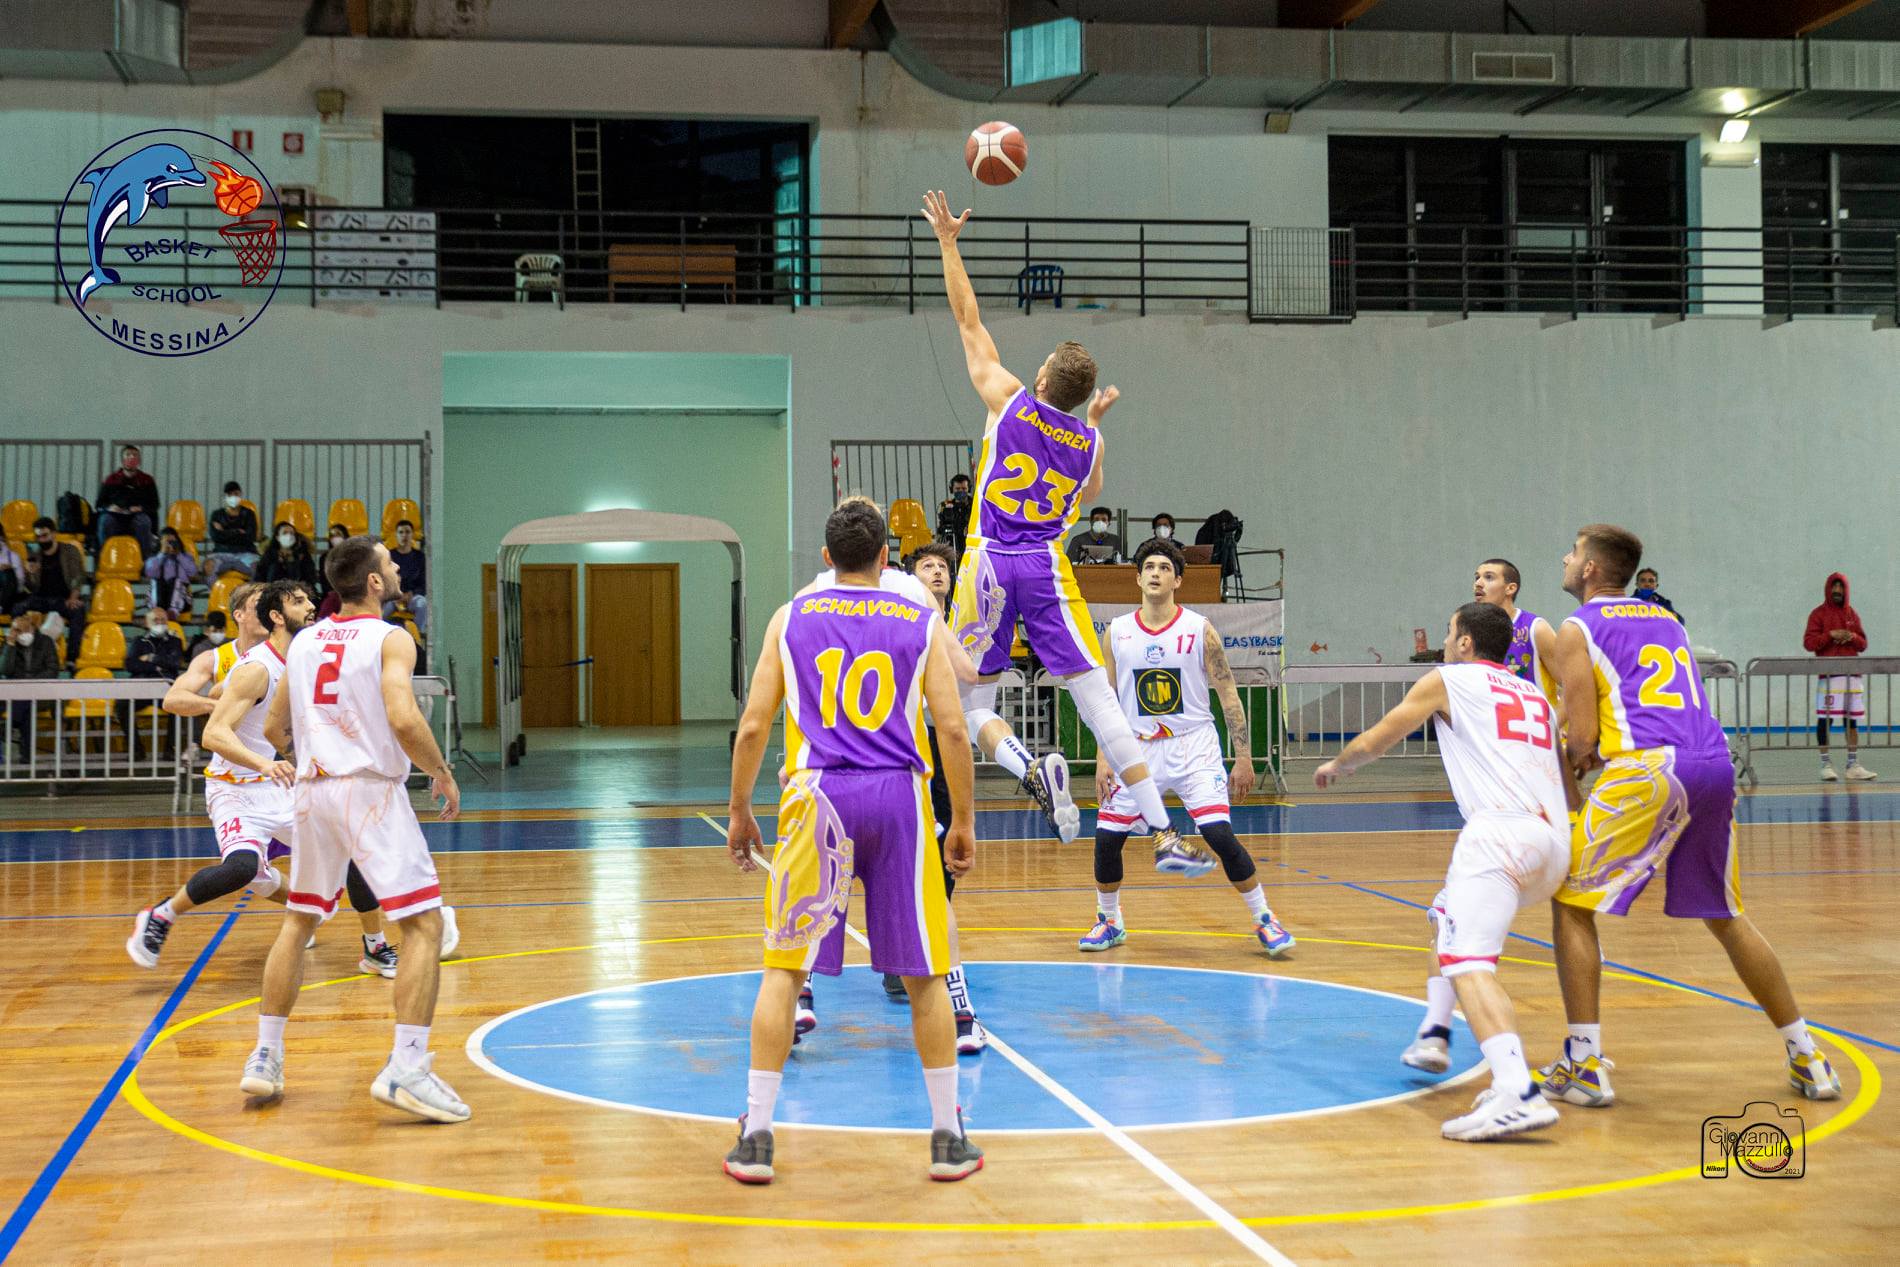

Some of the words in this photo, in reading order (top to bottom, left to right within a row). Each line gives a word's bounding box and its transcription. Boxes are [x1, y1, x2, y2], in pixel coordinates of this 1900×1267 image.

[1016, 406, 1092, 453] LANDGREN
[984, 452, 1079, 523] 23
[801, 597, 921, 623] SCHIAVONI
[312, 644, 346, 705] 2
[1177, 634, 1196, 654] 17
[815, 647, 897, 733] 10
[1637, 644, 1701, 710] 21
[1489, 685, 1553, 751] 23
[219, 816, 243, 842] 34
